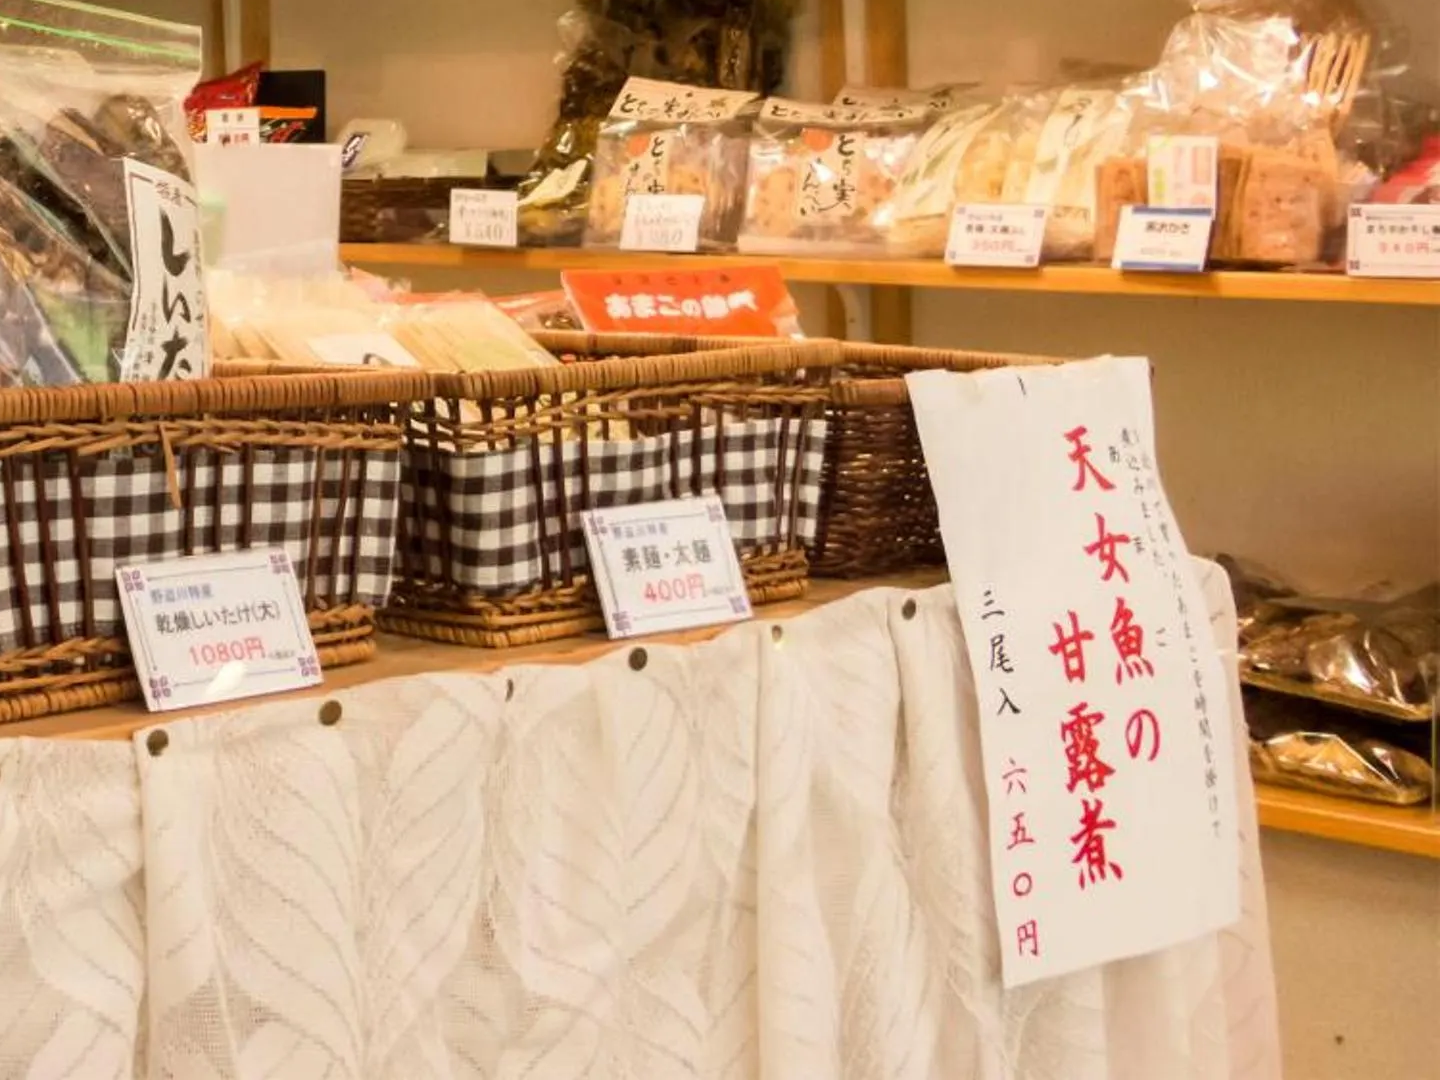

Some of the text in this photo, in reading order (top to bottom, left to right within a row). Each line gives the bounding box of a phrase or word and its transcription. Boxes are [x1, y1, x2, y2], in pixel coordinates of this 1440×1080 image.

[643, 573, 707, 604] 400円
[1063, 424, 1160, 762] 天女魚の
[156, 600, 281, 634] 乾燥しいたけ(大)
[188, 635, 266, 665] 1080円
[1047, 609, 1125, 891] 甘露煮
